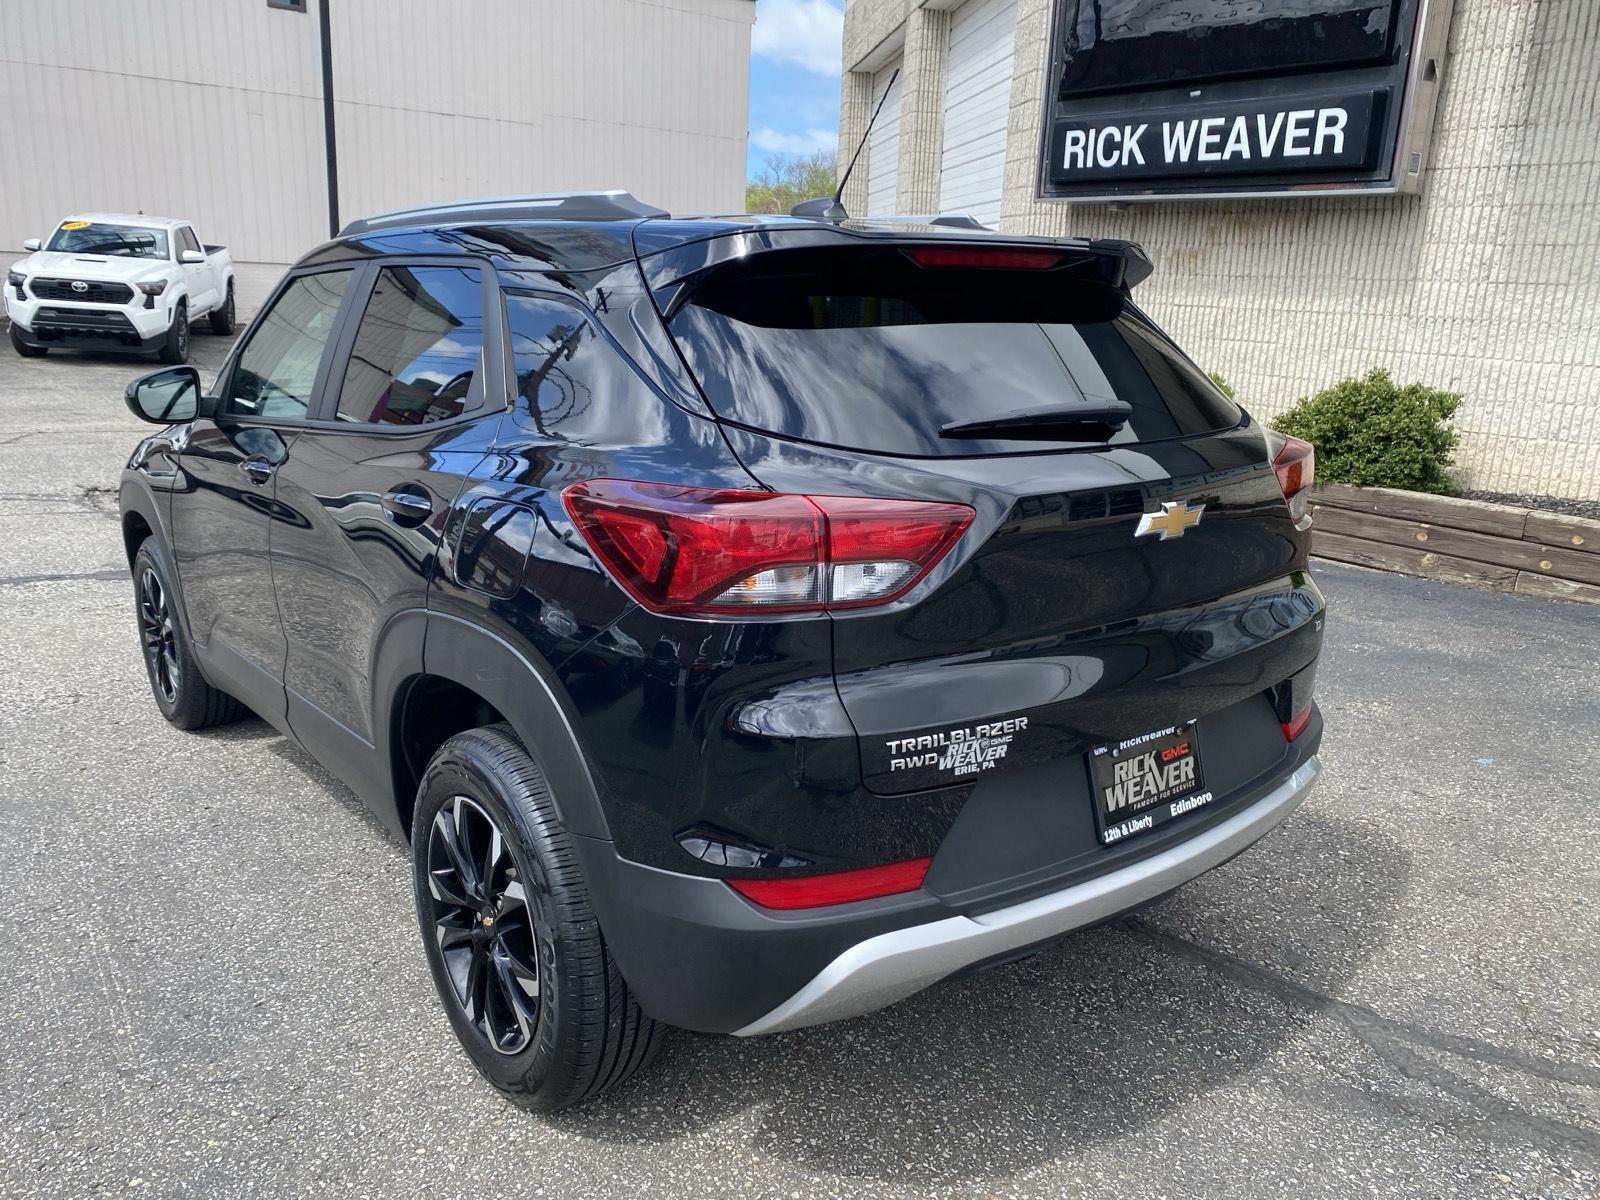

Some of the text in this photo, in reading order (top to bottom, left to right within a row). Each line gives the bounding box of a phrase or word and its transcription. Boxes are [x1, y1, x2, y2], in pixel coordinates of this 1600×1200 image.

[1063, 107, 1348, 169] RICK WEAVER
[886, 716, 1029, 755] TRAILBLAZER
[946, 740, 982, 757] RICK
[890, 753, 938, 771] AWD
[938, 744, 1008, 770] WEAVER
[1161, 742, 1190, 762] GMC
[954, 761, 995, 776] ERIE, PA
[1113, 750, 1157, 783] RICK
[1105, 755, 1195, 813] WEAVER
[1133, 779, 1196, 811] FAMOUS FOR SERVICE
[1169, 792, 1213, 817] Edinboro
[1103, 815, 1153, 843] 12th & Liberty
